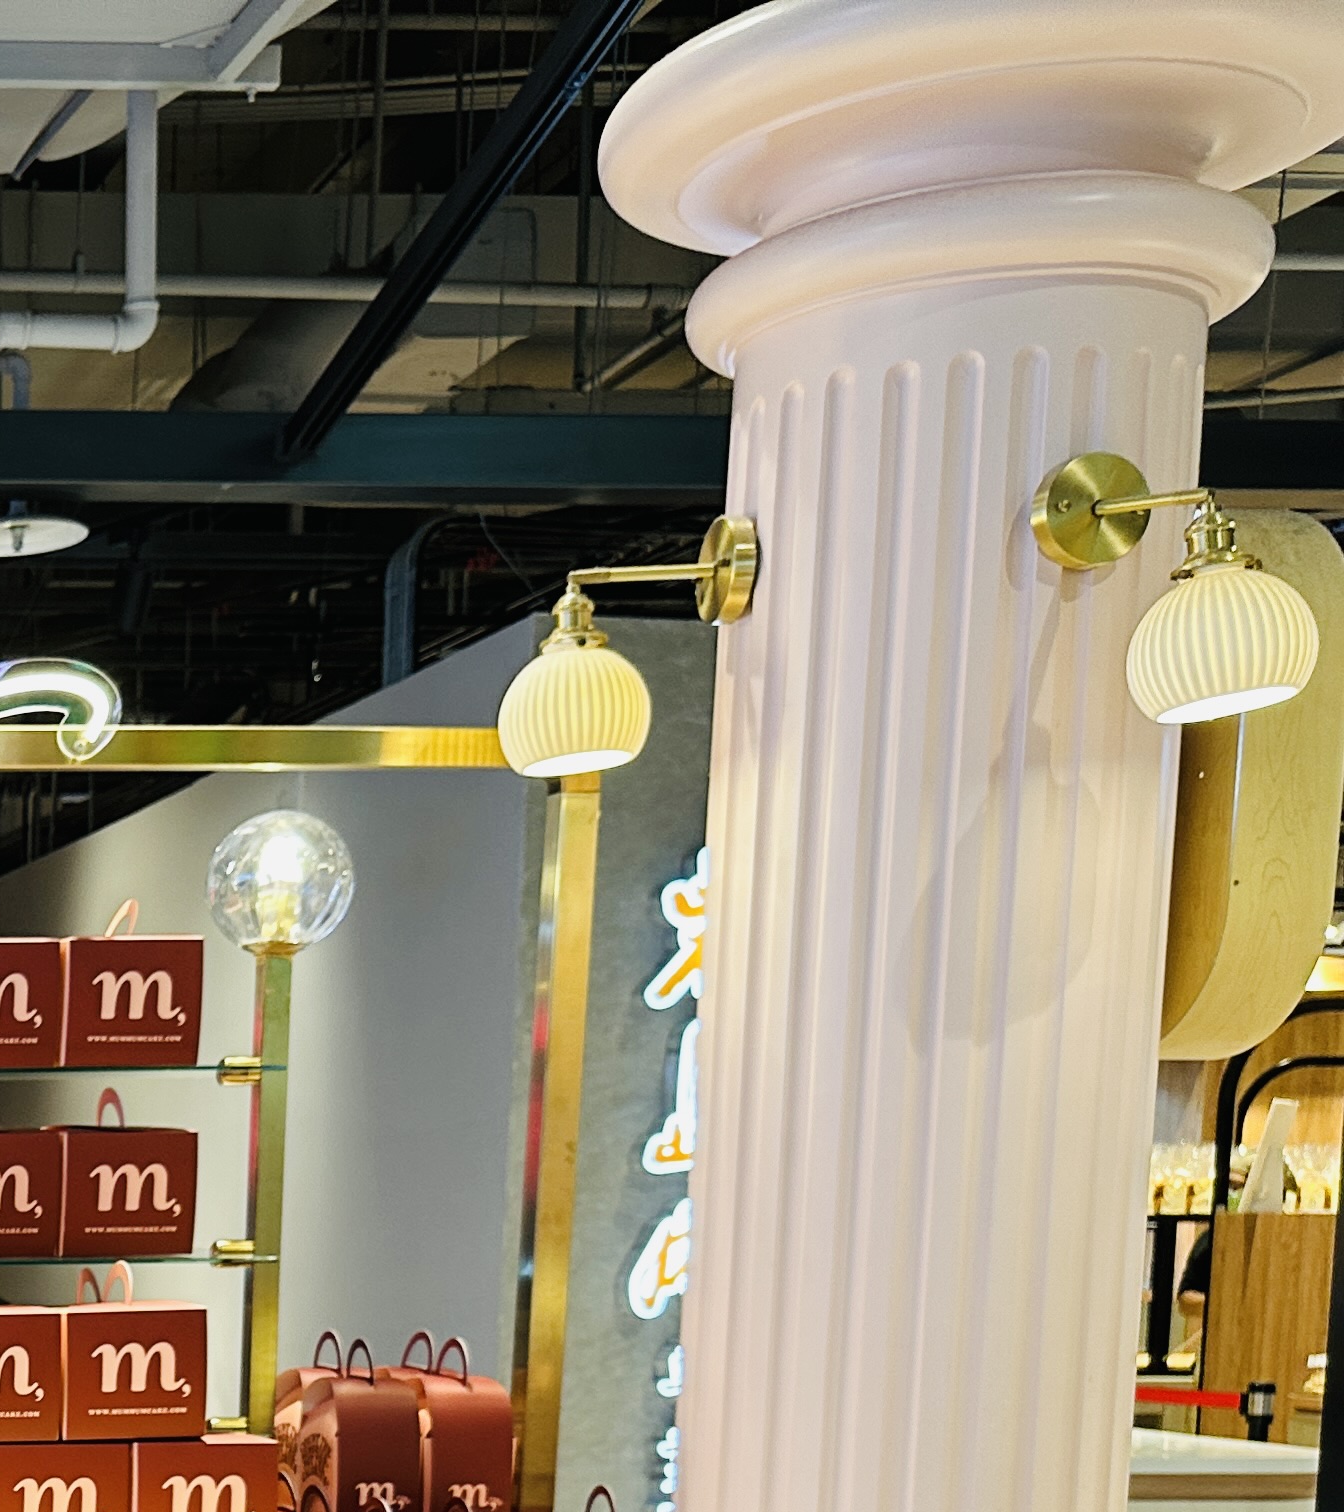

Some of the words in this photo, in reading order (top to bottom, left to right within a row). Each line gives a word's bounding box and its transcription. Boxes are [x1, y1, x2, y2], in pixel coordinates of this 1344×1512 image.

[92, 970, 186, 1027] m,
[89, 1163, 182, 1217] m,
[90, 1341, 192, 1398] m,
